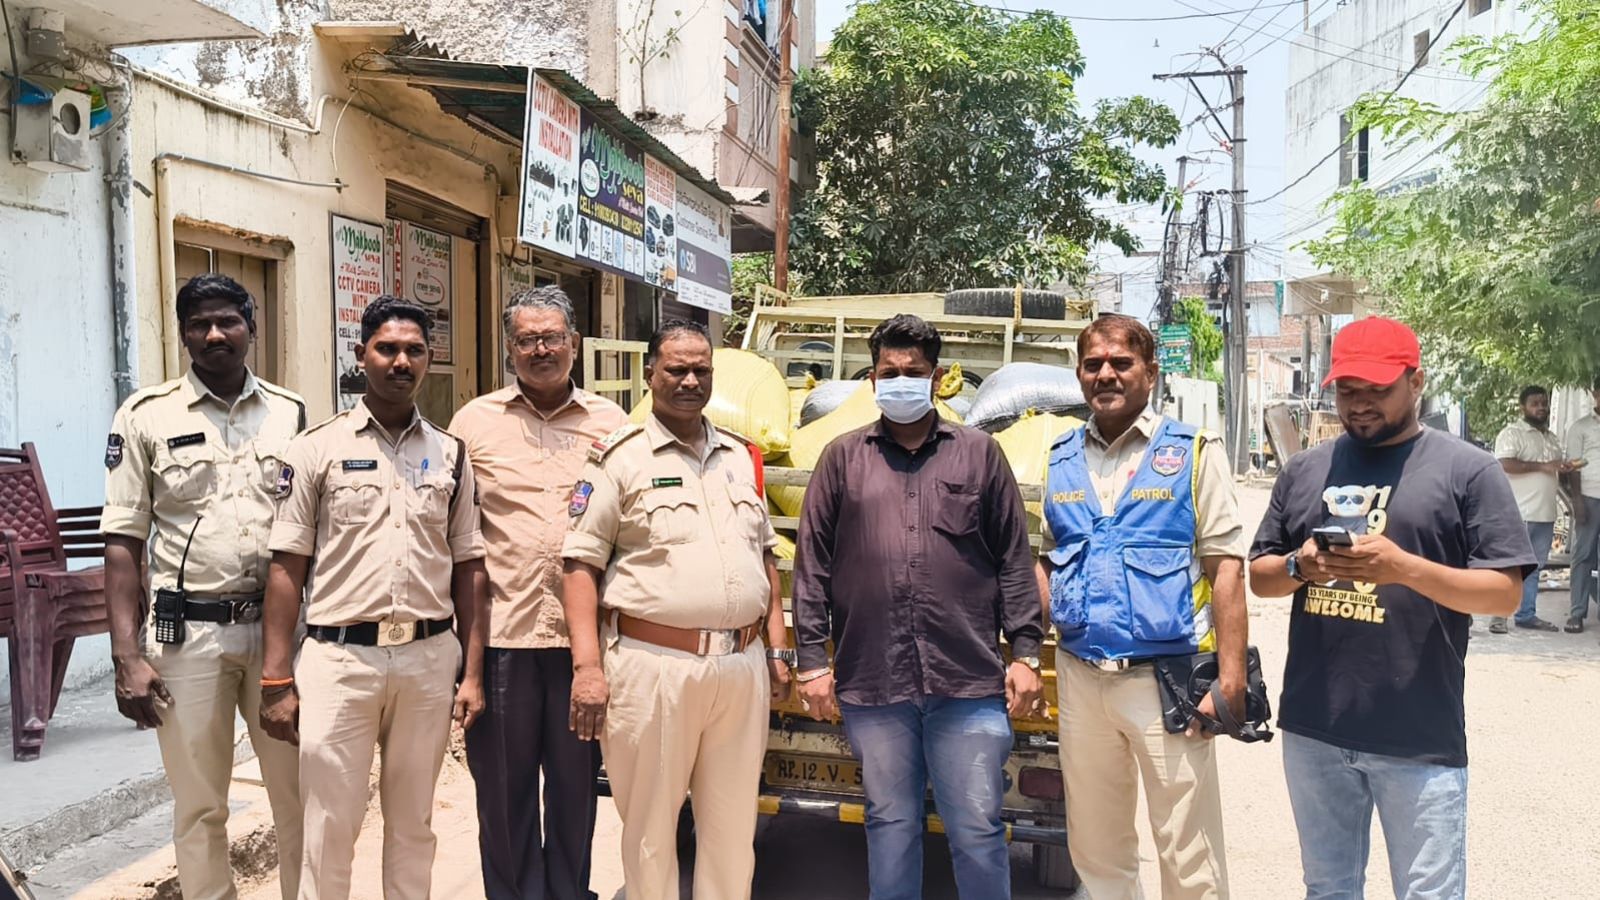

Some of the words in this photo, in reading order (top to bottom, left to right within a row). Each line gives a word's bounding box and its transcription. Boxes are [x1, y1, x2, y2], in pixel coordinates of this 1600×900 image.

[686, 250, 697, 275] SBI
[338, 275, 354, 291] CCTV
[356, 278, 380, 295] CAMERA
[352, 293, 368, 308] WITH
[1052, 490, 1085, 503] POLICE
[1131, 487, 1175, 501] PATROL
[1318, 589, 1337, 599] YEARS
[1338, 591, 1347, 600] OF
[1349, 593, 1373, 604] BEING
[1304, 598, 1386, 624] AWESOME
